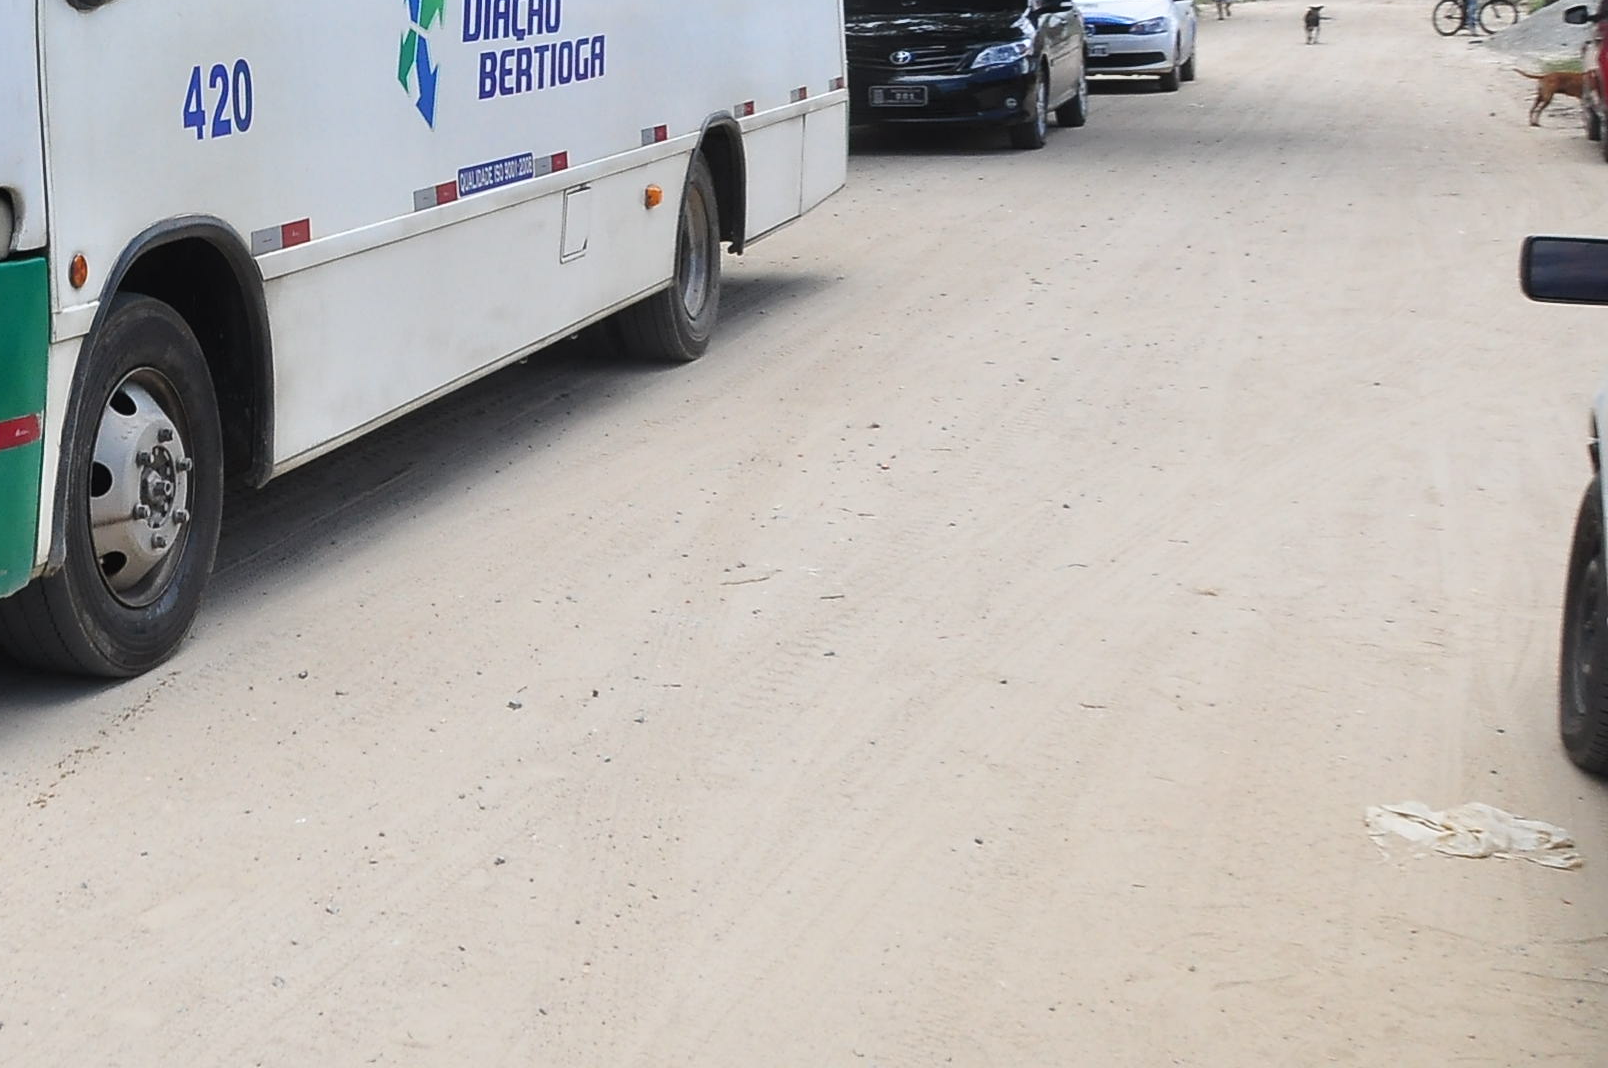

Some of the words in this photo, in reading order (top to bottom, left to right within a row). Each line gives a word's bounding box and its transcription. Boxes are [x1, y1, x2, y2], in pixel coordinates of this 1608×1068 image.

[183, 58, 253, 140] 420
[478, 35, 605, 100] BERTIOGA
[459, 167, 494, 193] QUALIDADE
[493, 162, 504, 183] ISO
